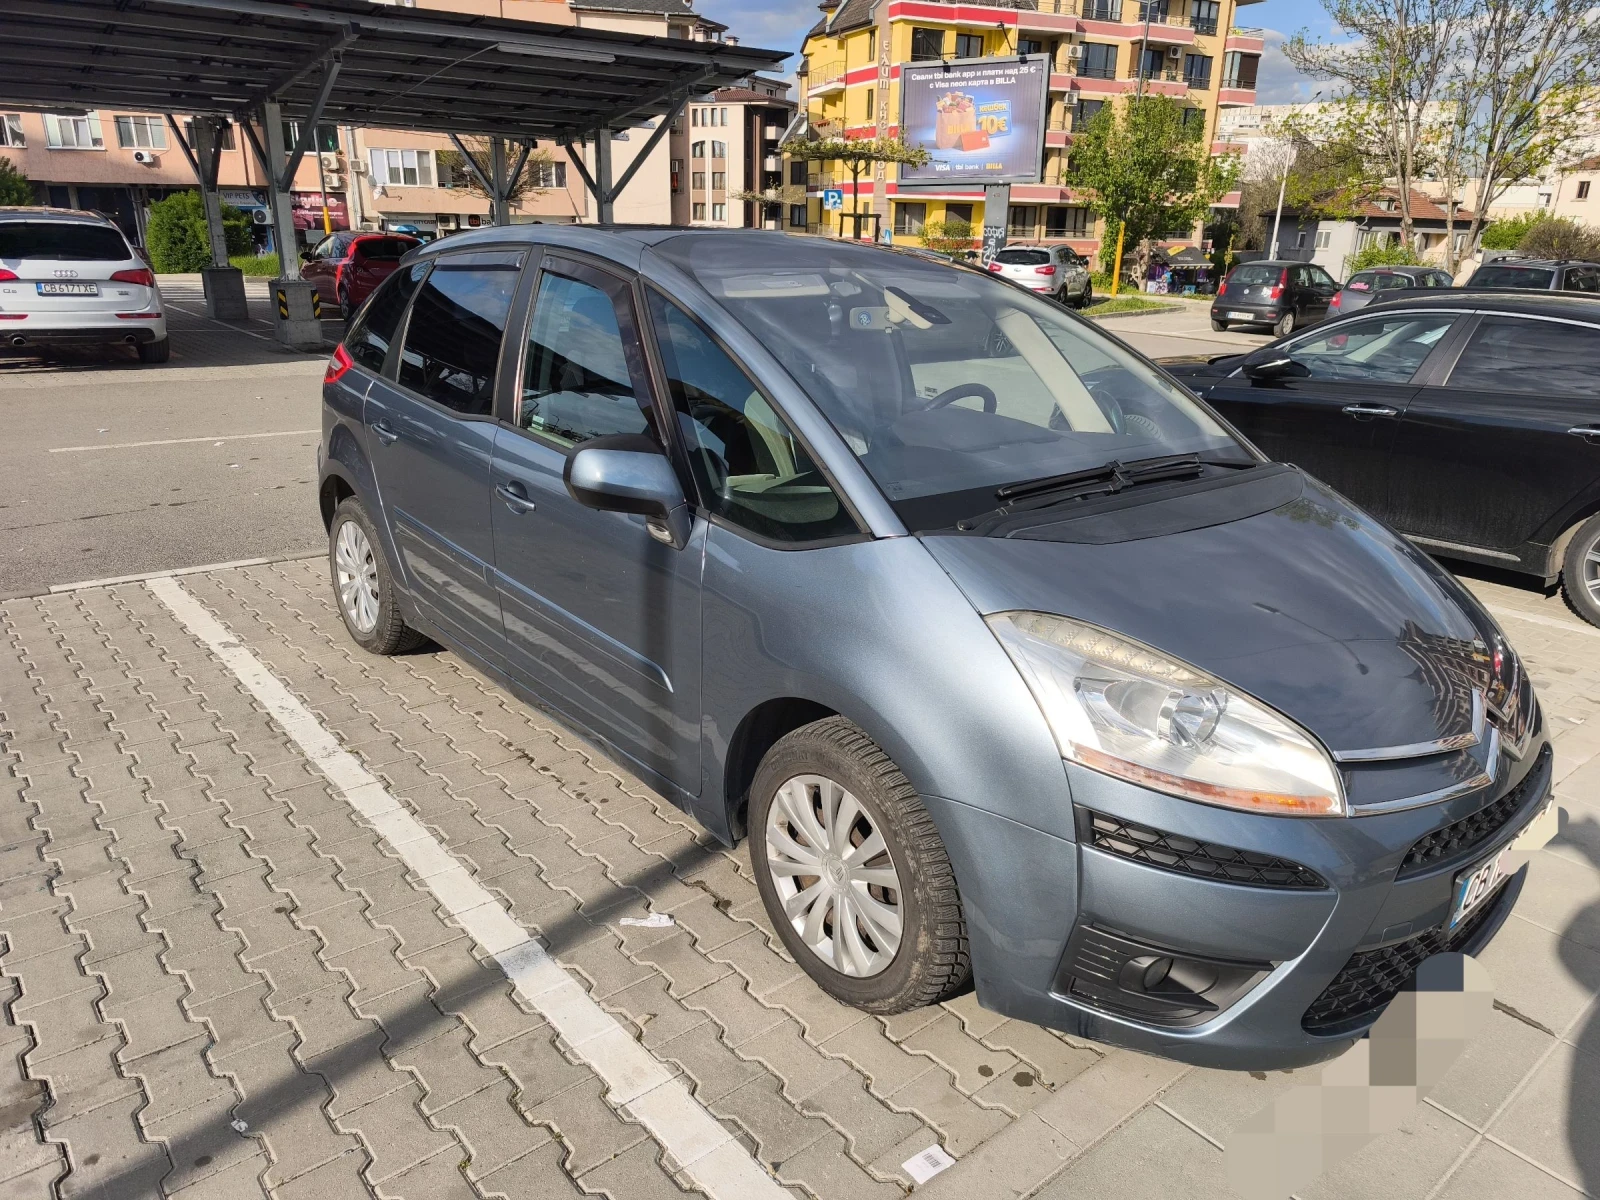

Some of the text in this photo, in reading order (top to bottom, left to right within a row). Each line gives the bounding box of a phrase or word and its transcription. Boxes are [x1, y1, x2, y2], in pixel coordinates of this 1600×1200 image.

[911, 73, 933, 81] Свали
[933, 72, 944, 80] tbi
[944, 71, 961, 79] bank
[962, 70, 975, 79] app
[982, 69, 1004, 77] плати
[1004, 68, 1018, 76] над
[935, 81, 950, 89] Visa
[950, 80, 968, 88] neon
[968, 79, 989, 88] карта
[995, 76, 1016, 85] BILLA
[985, 162, 1003, 170] BILLA
